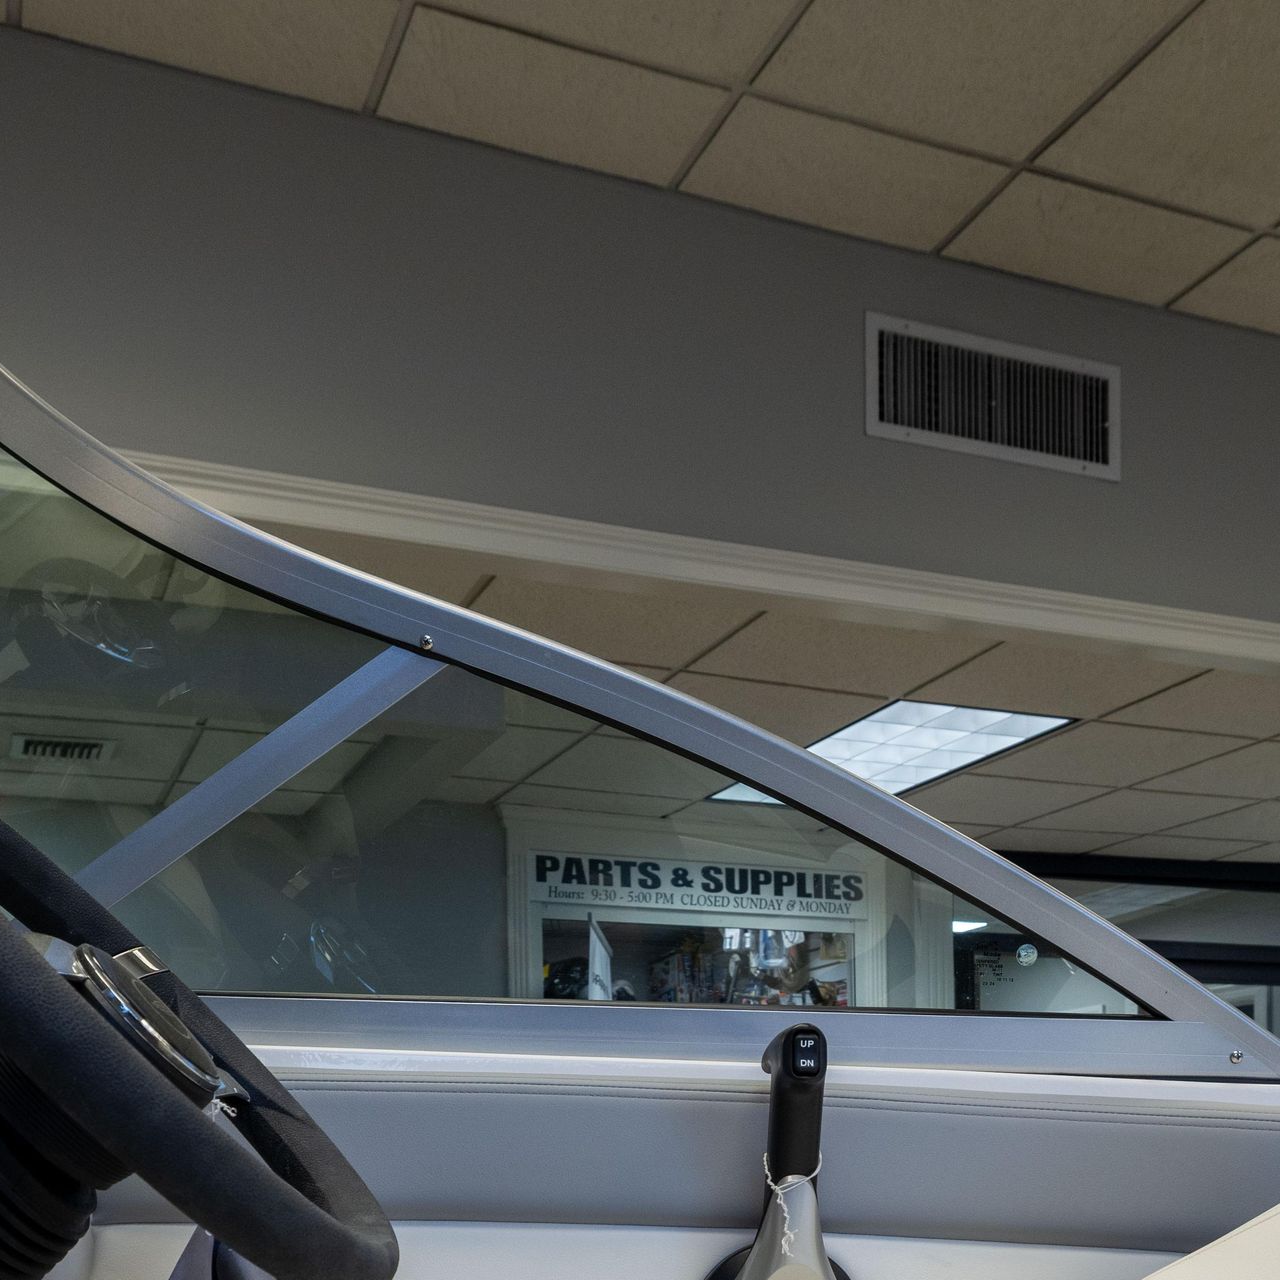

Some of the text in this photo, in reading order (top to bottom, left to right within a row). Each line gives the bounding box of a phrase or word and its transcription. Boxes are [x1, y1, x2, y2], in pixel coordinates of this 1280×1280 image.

[536, 855, 863, 901] PARTS & SUPPLIES
[548, 886, 585, 899] Hours:
[591, 888, 617, 902] 9:30
[627, 891, 652, 904] 5:00
[655, 892, 675, 905] PM
[680, 893, 730, 908] CLOSED
[733, 897, 783, 911] SUNDAY
[786, 900, 797, 911] &
[798, 900, 852, 914] MONDAY
[800, 1040, 814, 1048] UP
[800, 1059, 814, 1067] DN
